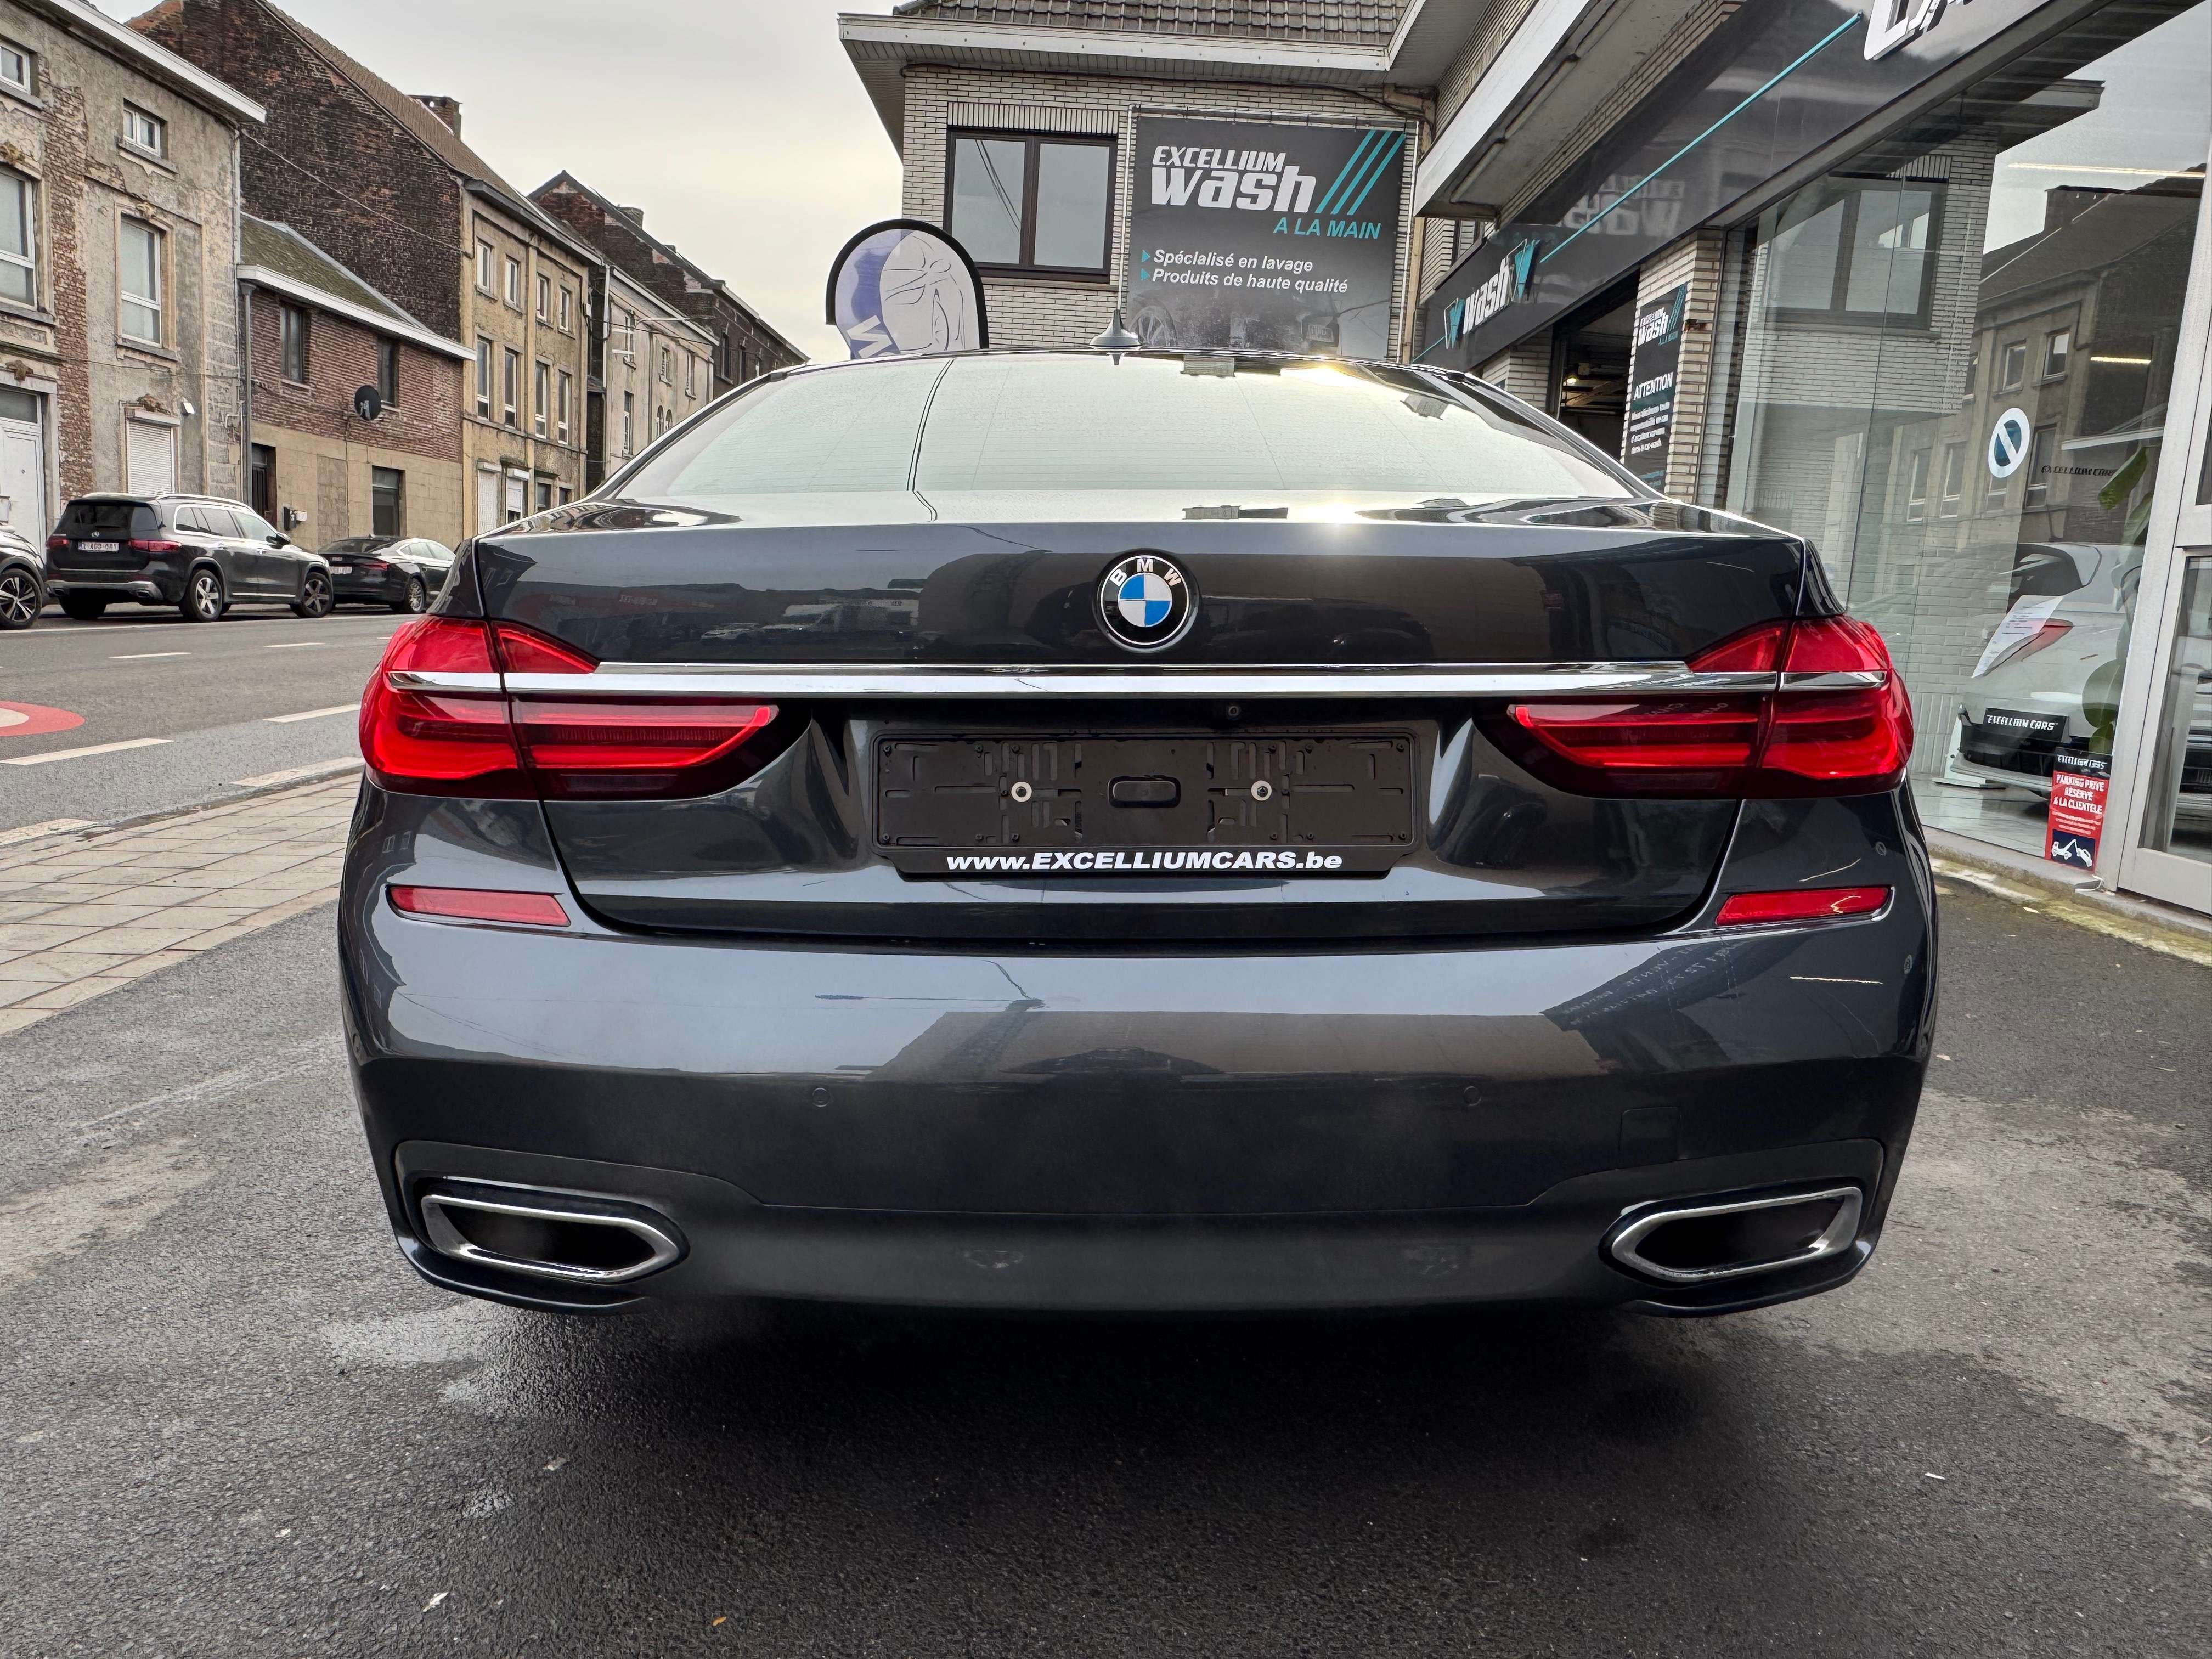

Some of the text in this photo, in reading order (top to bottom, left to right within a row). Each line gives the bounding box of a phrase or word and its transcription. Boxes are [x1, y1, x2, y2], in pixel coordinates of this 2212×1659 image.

[1152, 146, 1286, 172] EXCELLIUM
[1273, 217, 1381, 239] A LA MAIN
[1154, 249, 1313, 274] Spécialisé en lavage
[1152, 268, 1348, 294] Produits de haute qualité
[1633, 371, 1674, 401] ATTENTION
[1109, 558, 1182, 587] BMW
[2030, 720, 2058, 731] CARS
[946, 851, 1343, 870] www.EXCELLIUMCARS.be
